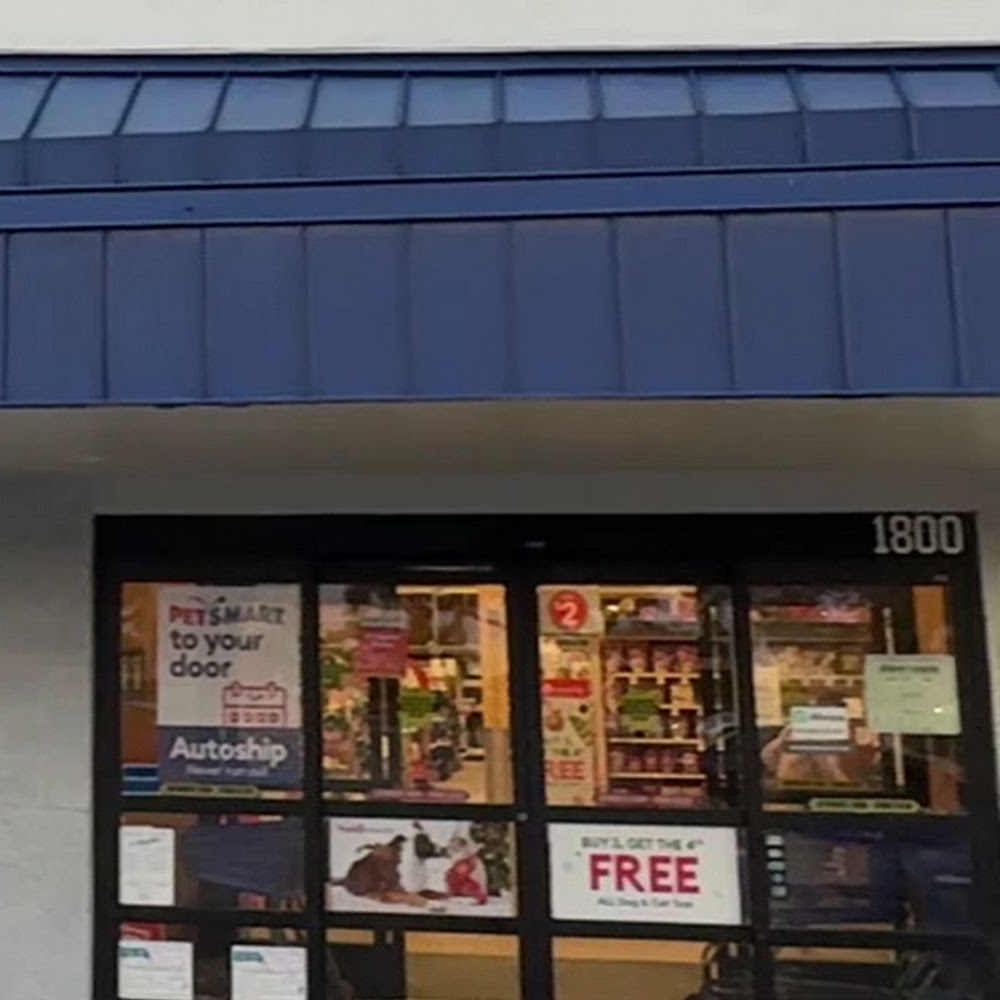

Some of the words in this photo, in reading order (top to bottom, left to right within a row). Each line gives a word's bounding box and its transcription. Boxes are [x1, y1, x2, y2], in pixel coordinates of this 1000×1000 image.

[872, 514, 964, 555] 1800
[169, 604, 285, 626] PETSMART
[170, 629, 199, 650] to
[203, 633, 264, 656] your
[170, 653, 231, 678] door
[169, 736, 288, 768] Autoship
[581, 836, 609, 848] BUY
[626, 837, 653, 850] GET
[657, 838, 682, 850] THE
[589, 853, 700, 894] FREE
